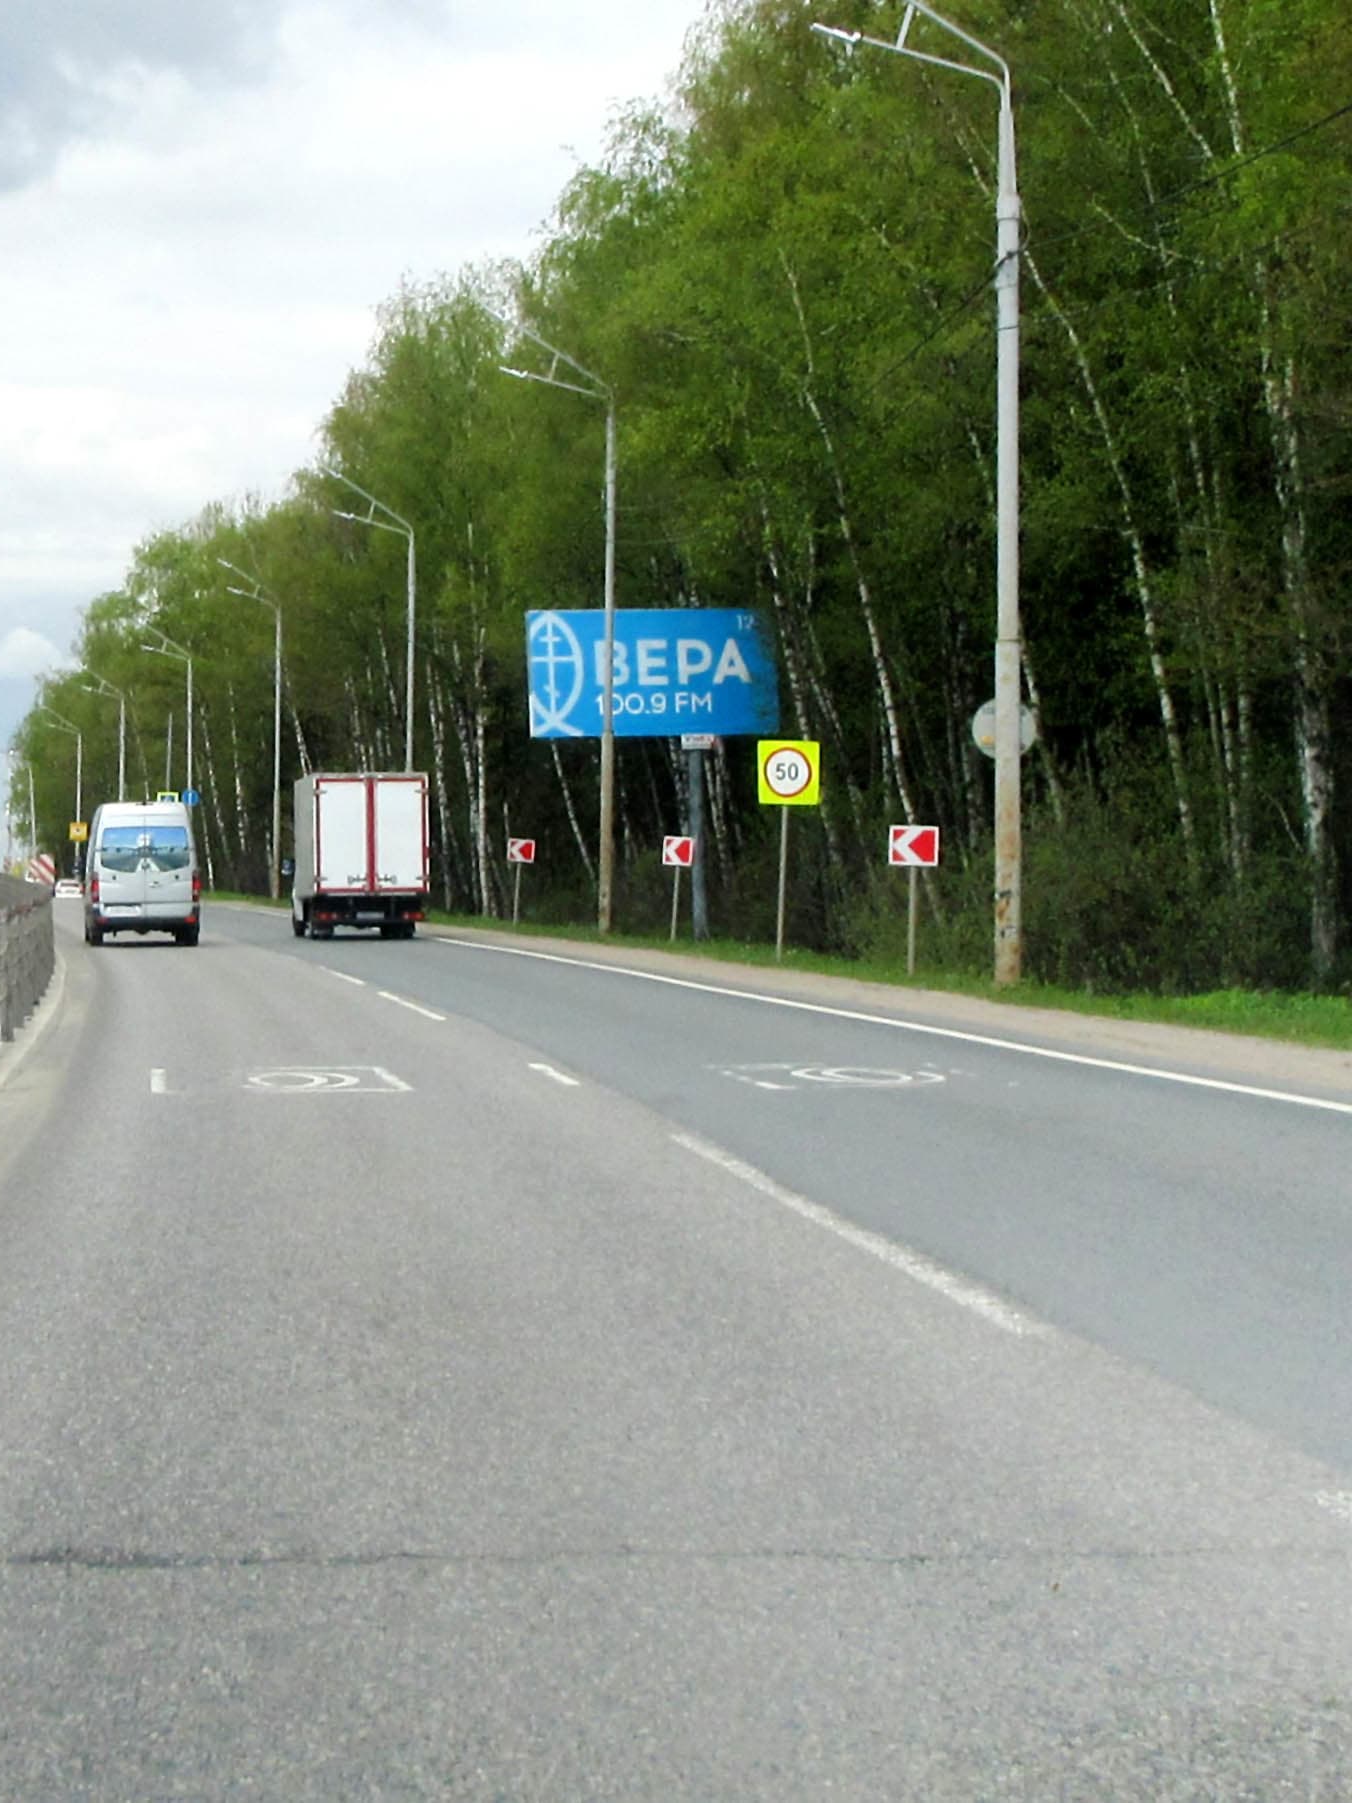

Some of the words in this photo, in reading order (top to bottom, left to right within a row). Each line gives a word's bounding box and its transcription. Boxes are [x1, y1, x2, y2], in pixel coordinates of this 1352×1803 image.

[594, 638, 752, 686] ВЕРА
[595, 692, 667, 715] 100.9
[674, 692, 713, 714] FM
[775, 762, 799, 781] 50
